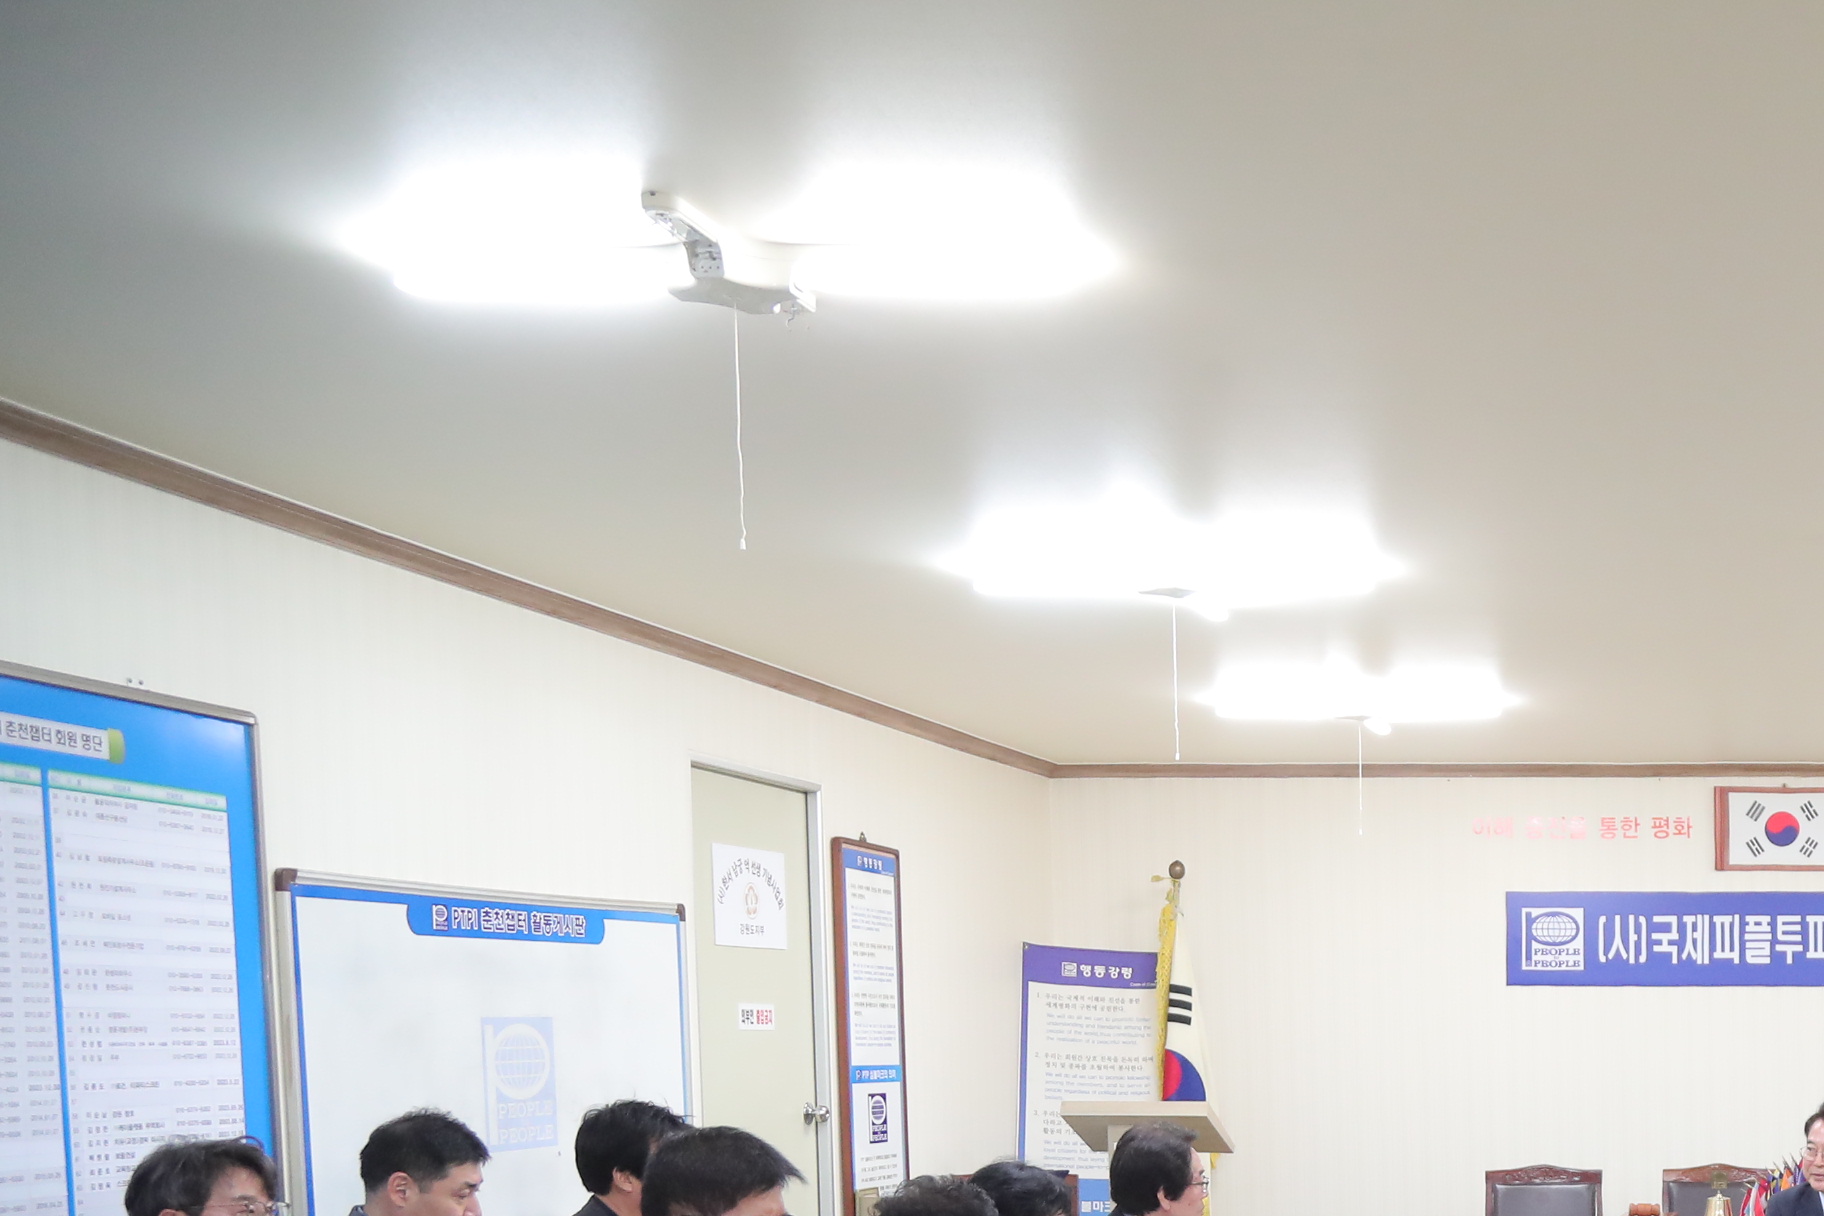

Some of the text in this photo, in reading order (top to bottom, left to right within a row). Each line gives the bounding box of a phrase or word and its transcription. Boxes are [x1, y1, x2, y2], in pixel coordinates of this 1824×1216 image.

[6, 721, 103, 752] 춘천챕터 회원 명단
[1599, 816, 1640, 839] 통한
[1651, 816, 1692, 839] 평화
[452, 907, 587, 937] PTPI 춘천챕터 활동게시판
[740, 923, 765, 936] 강원도지부
[1533, 948, 1581, 956] PEOPLE
[1080, 964, 1133, 980] 행동강령
[1533, 959, 1581, 968] PEOPLE
[1045, 1052, 1061, 1060] 우리는
[499, 1100, 553, 1119] PEOPLE
[499, 1125, 554, 1144] PEOPLE
